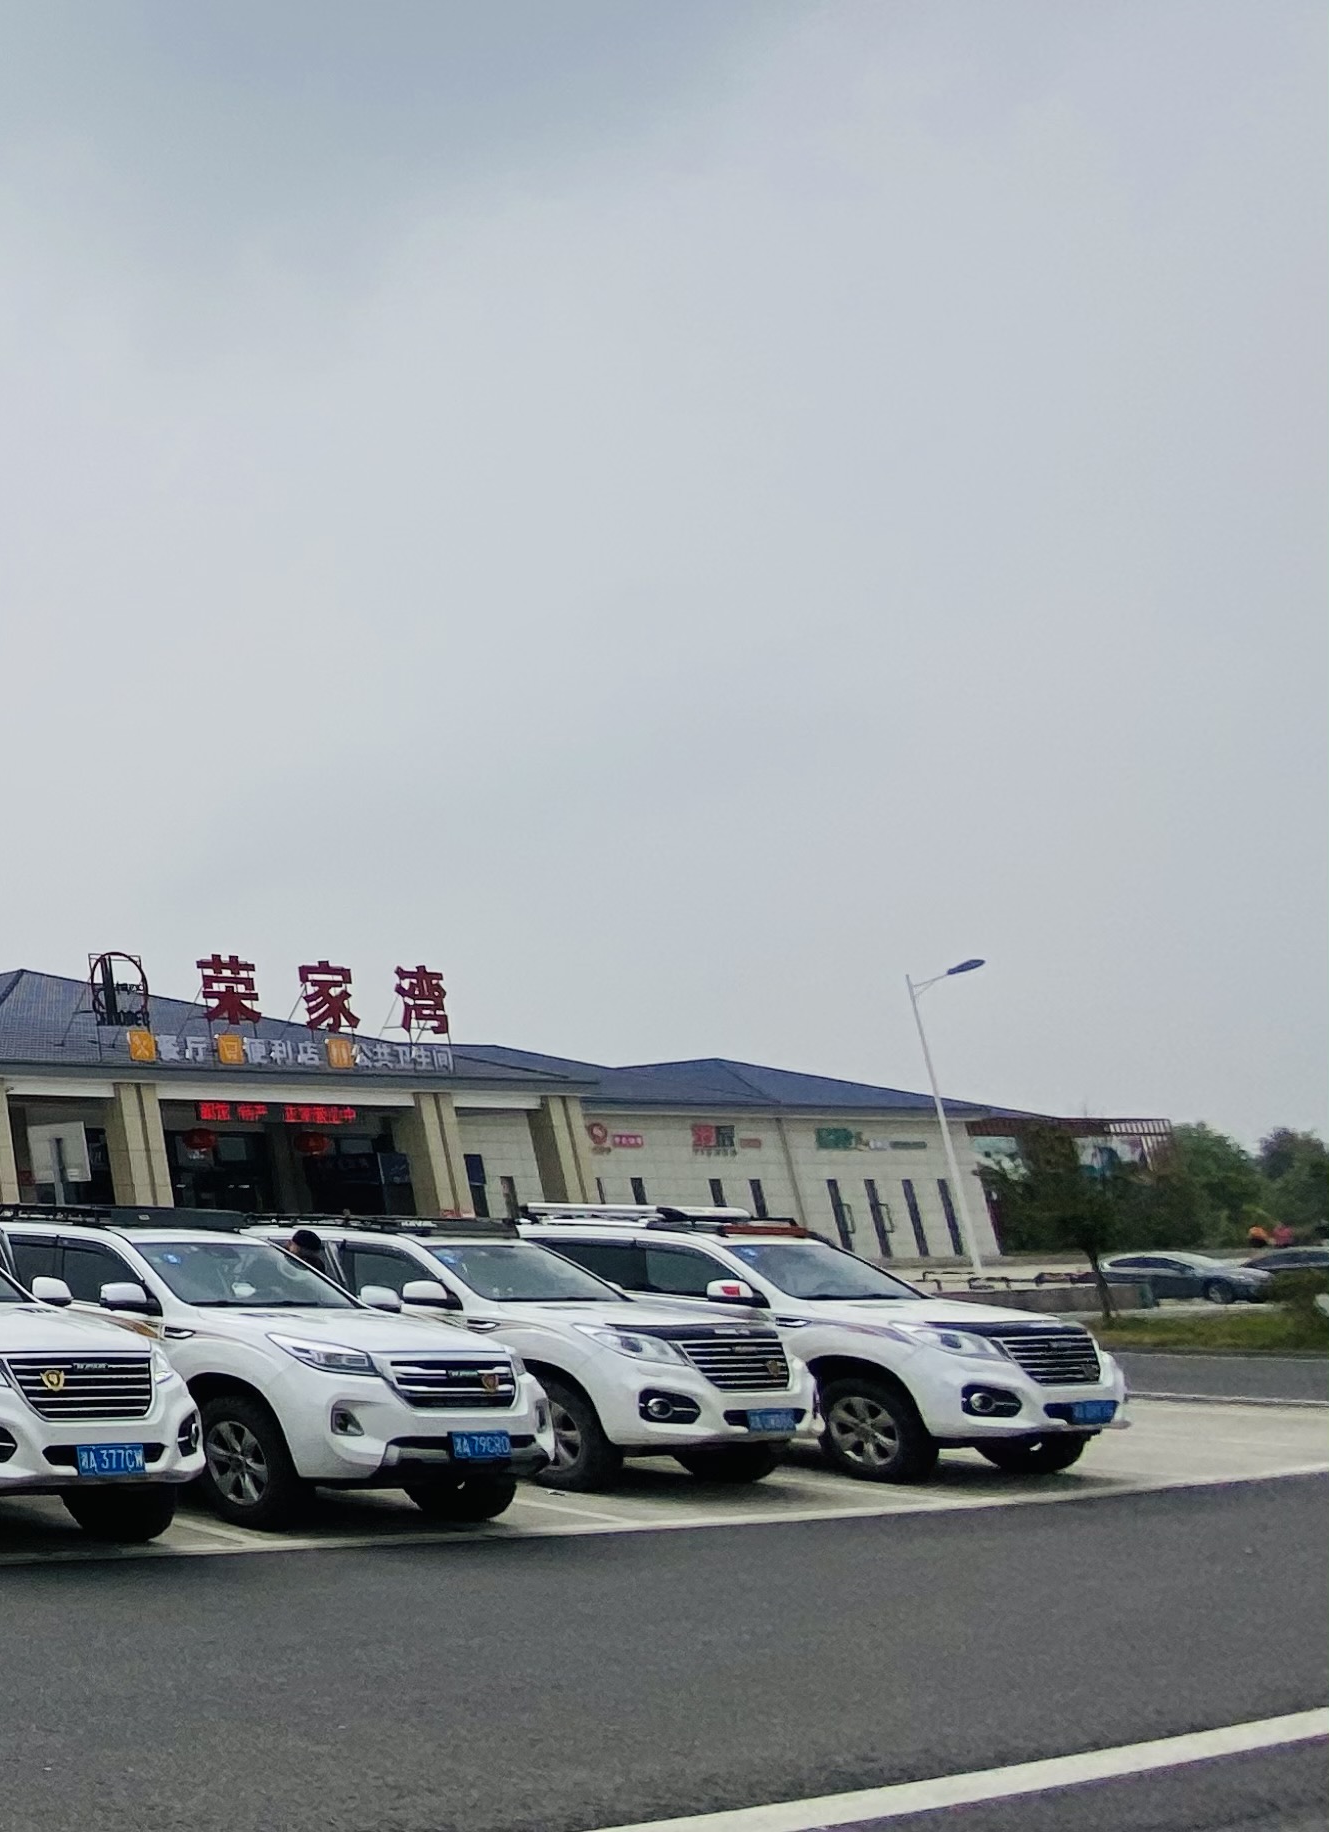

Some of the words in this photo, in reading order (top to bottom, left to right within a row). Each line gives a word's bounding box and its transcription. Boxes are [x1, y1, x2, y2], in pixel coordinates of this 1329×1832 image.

[196, 954, 449, 1034] 荣家湾
[156, 1034, 209, 1062] 餐厅
[243, 1036, 320, 1067] 便利店
[352, 1043, 455, 1074] 公共卫生间
[100, 1449, 143, 1469] 377CW
